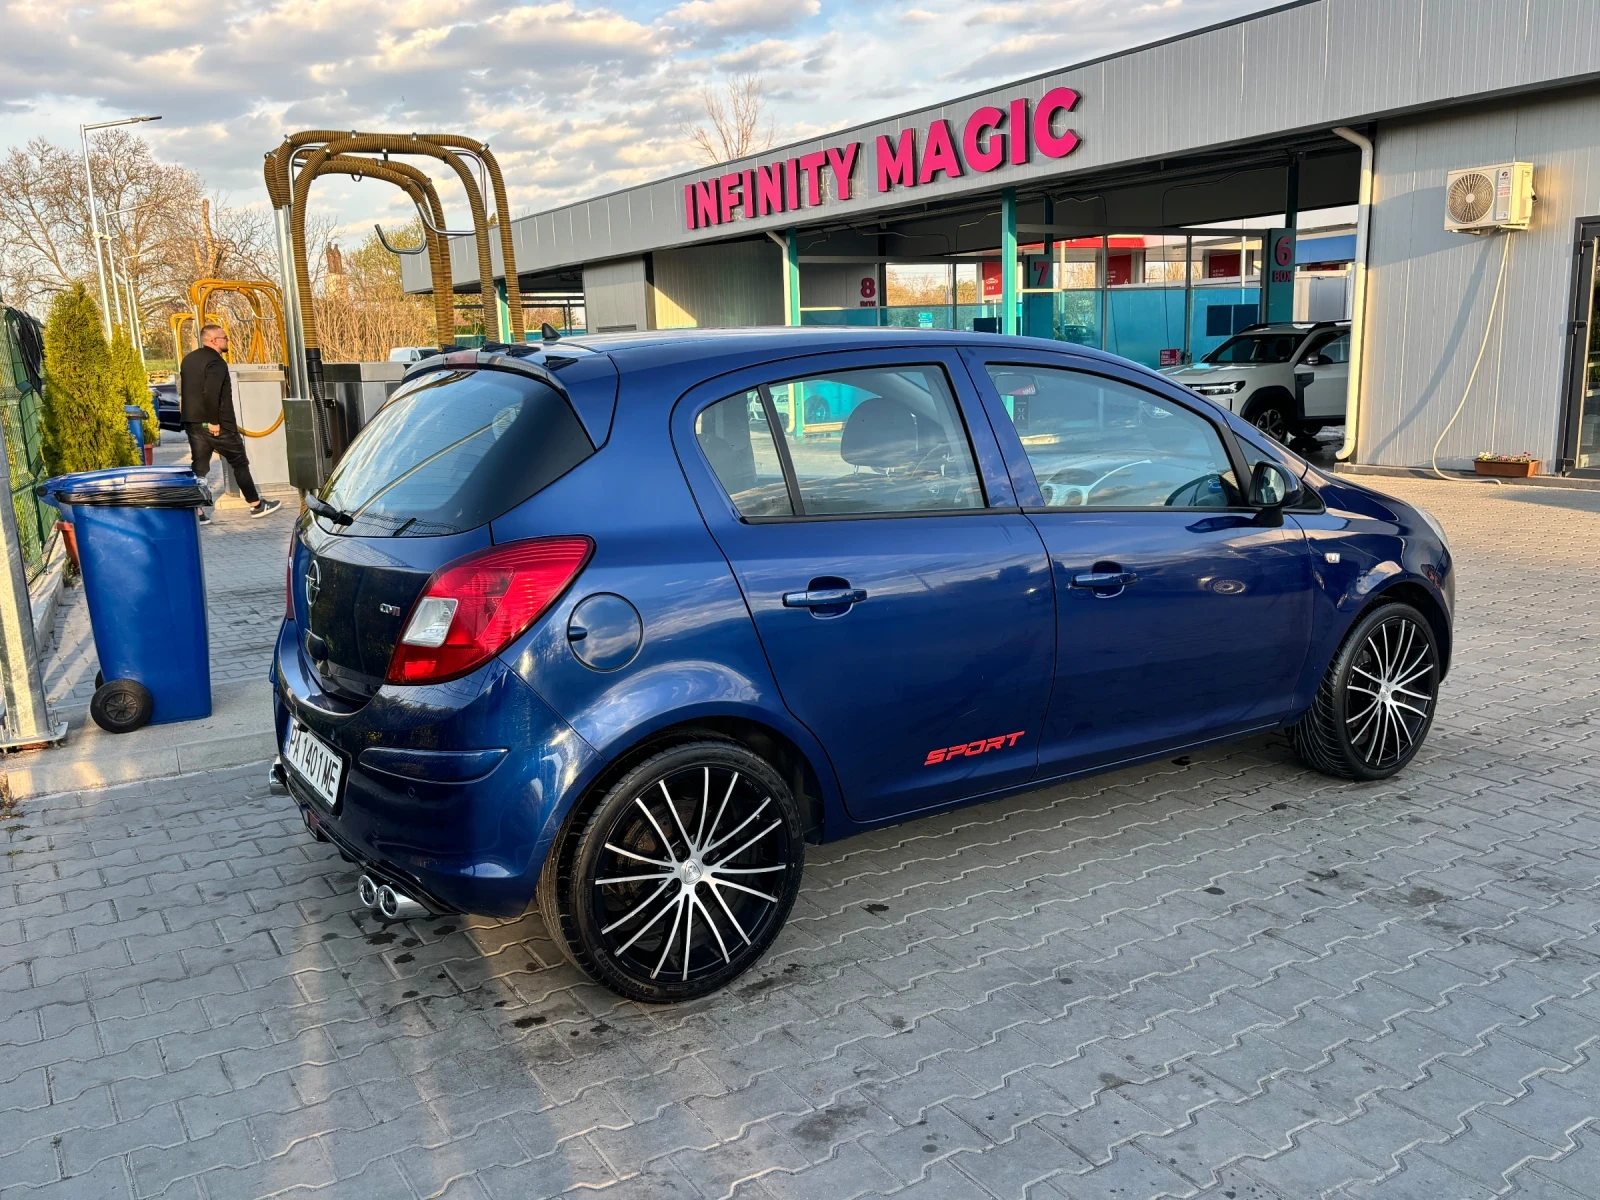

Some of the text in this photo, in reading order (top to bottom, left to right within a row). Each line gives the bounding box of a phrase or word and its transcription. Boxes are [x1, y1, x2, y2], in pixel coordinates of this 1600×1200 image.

[684, 87, 1081, 230] INFINITY MAGIC
[1275, 236, 1292, 266] 6
[861, 278, 876, 298] 8
[1035, 261, 1050, 286] 7
[1273, 271, 1292, 282] BOX
[301, 736, 324, 783] 1401
[924, 731, 1025, 766] SPORT
